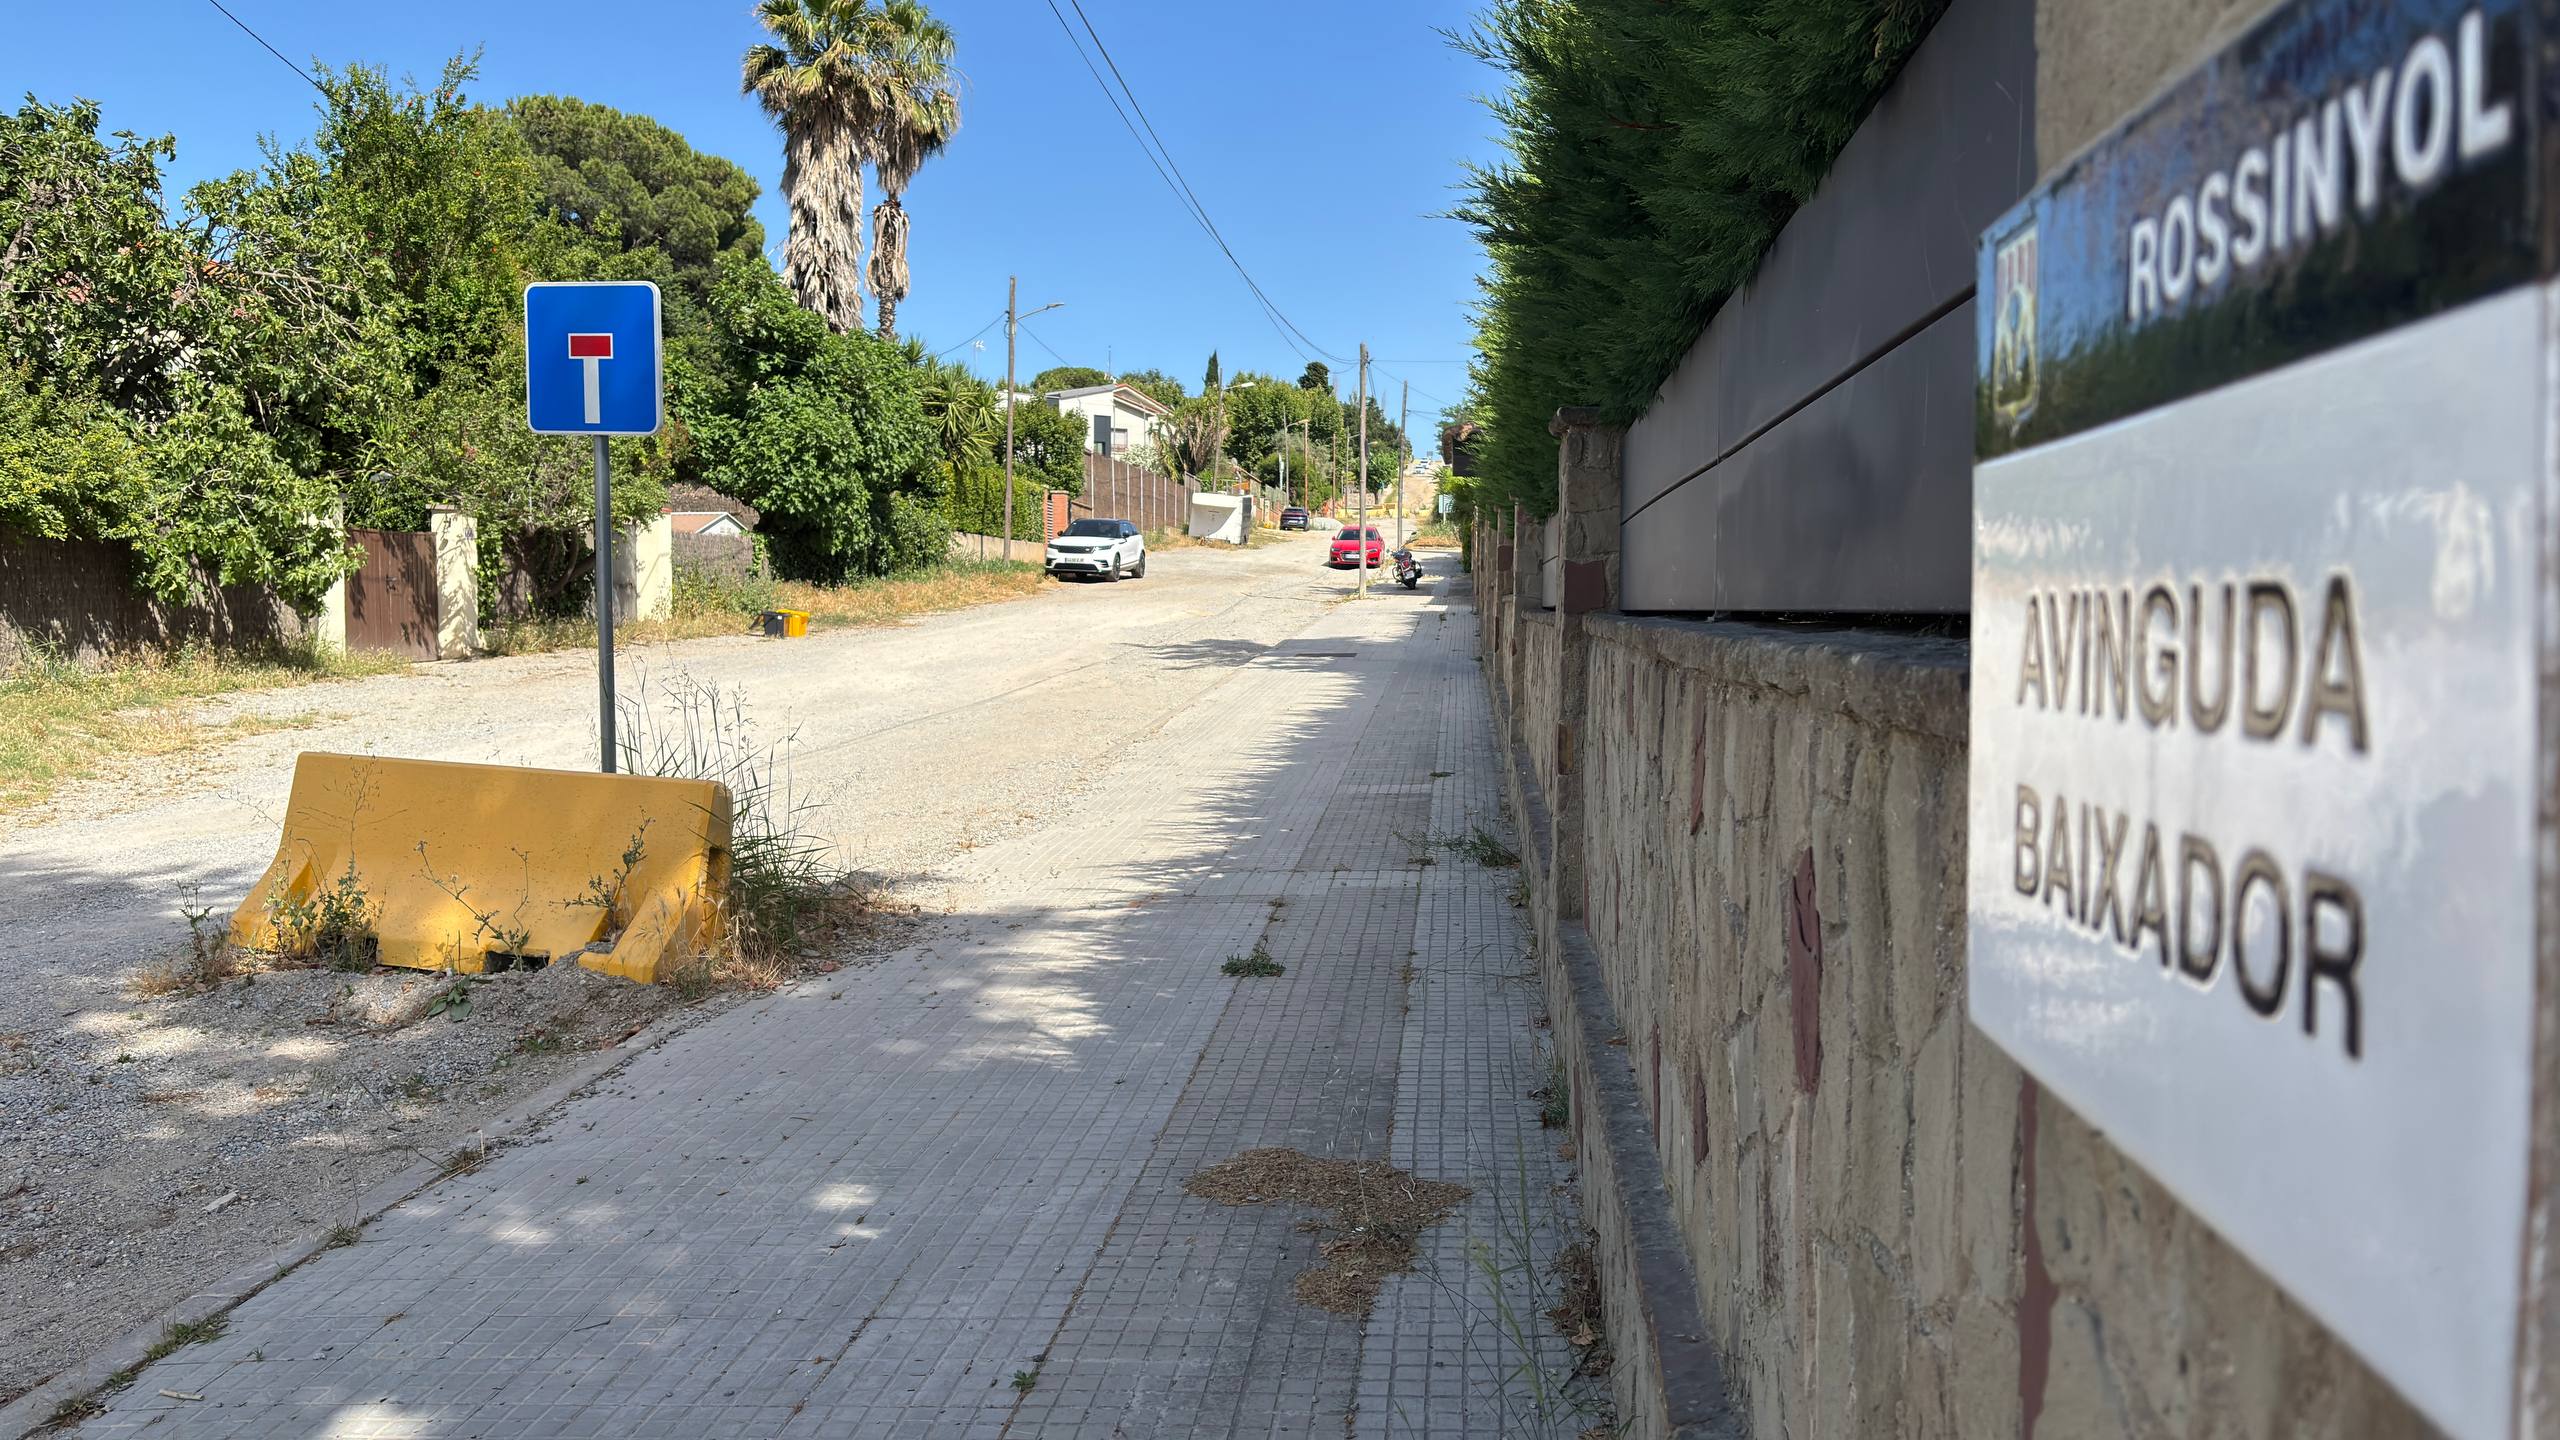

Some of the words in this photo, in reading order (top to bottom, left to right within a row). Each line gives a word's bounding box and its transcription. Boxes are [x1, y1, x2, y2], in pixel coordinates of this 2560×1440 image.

[2127, 10, 2512, 321] ROSSINYOL
[2017, 574, 2369, 754] AVINGUDA
[2014, 784, 2366, 1061] BAIXADOR
